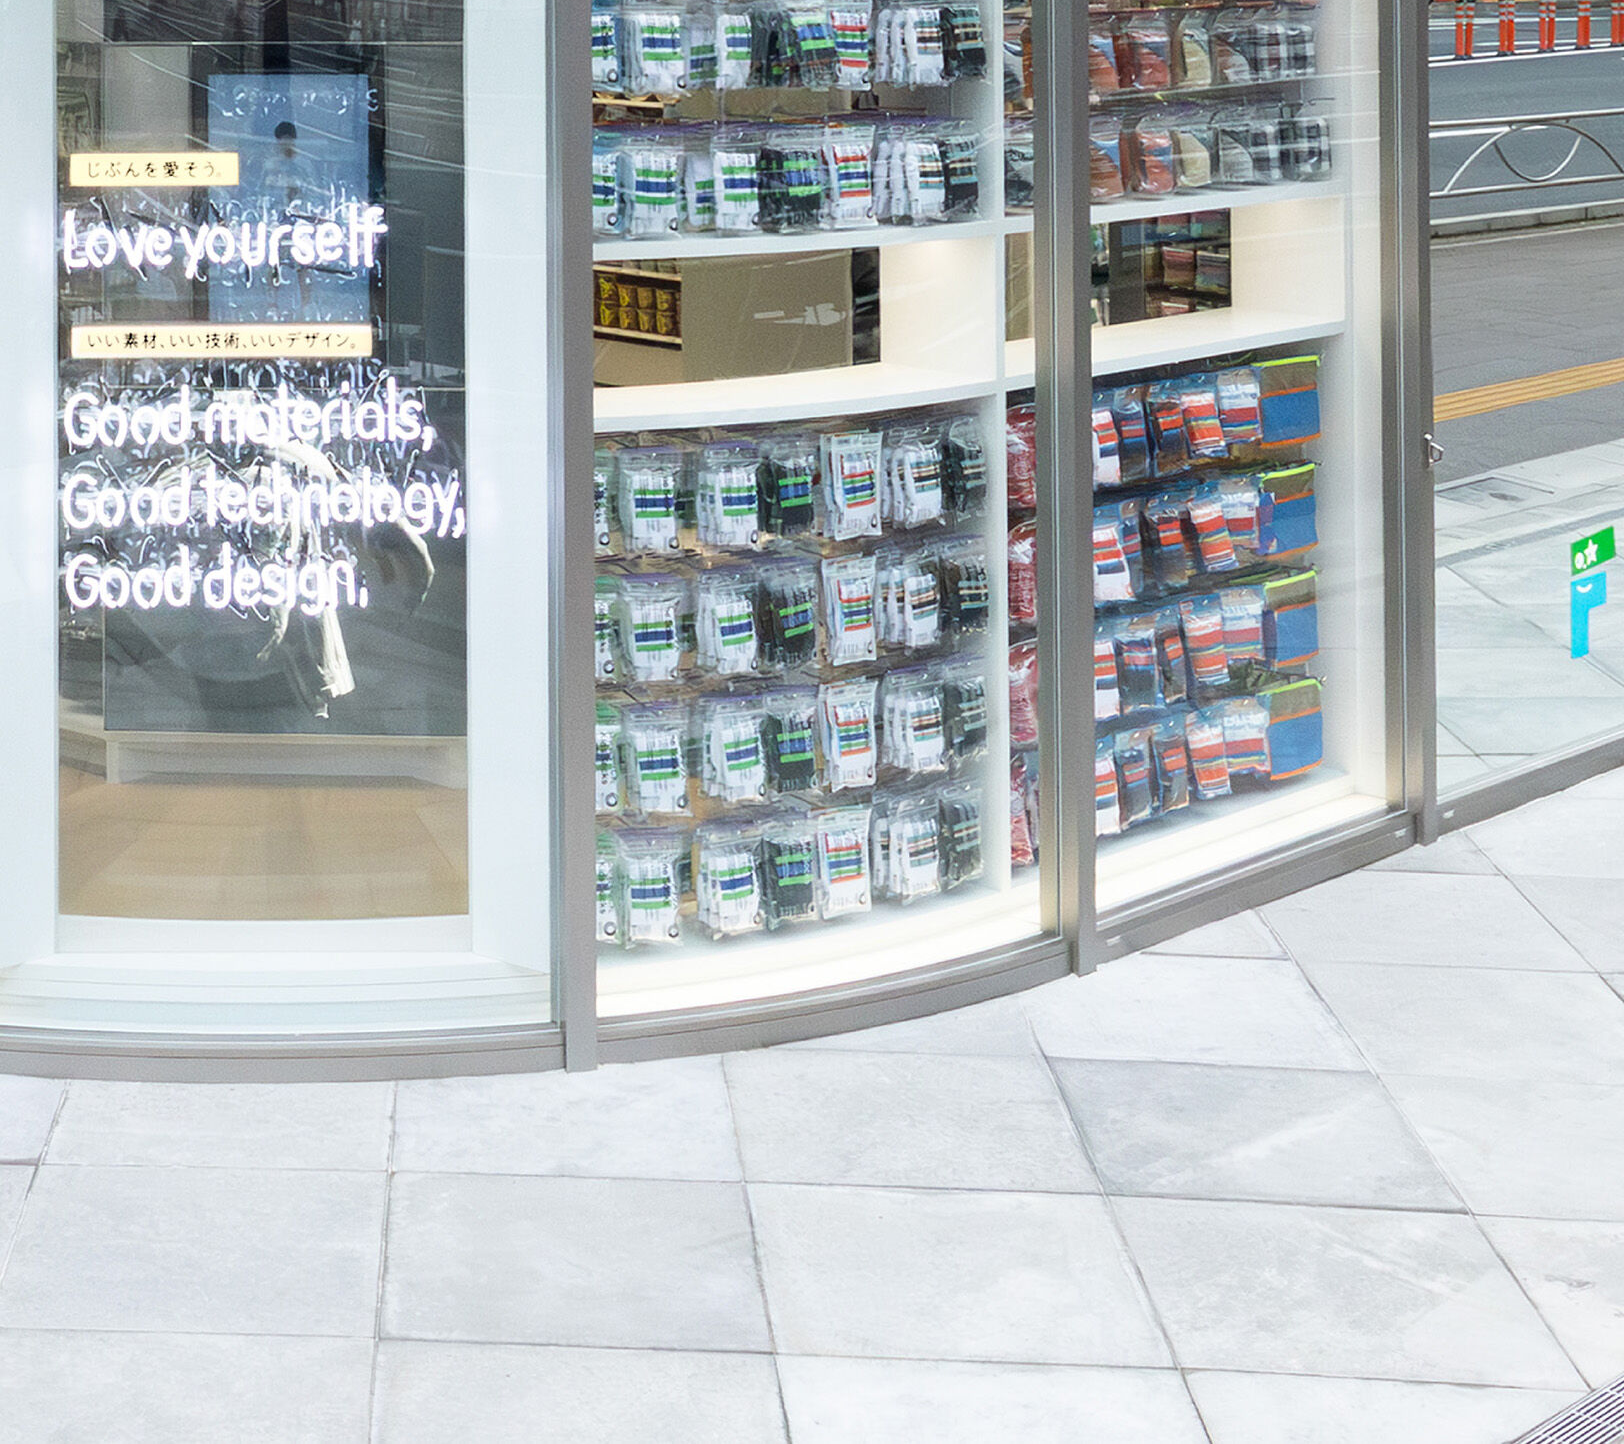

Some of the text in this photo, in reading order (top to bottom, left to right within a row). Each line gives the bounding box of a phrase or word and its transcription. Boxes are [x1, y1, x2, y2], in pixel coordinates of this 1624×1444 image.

[87, 160, 223, 179] じぶんを愛そう。
[63, 202, 389, 278] Love yourself
[87, 331, 357, 351] いい素材、いい技術、いいデザイン。
[63, 375, 434, 452] Good materials,
[62, 460, 466, 539] Good technology,
[63, 541, 369, 616] Good design.
